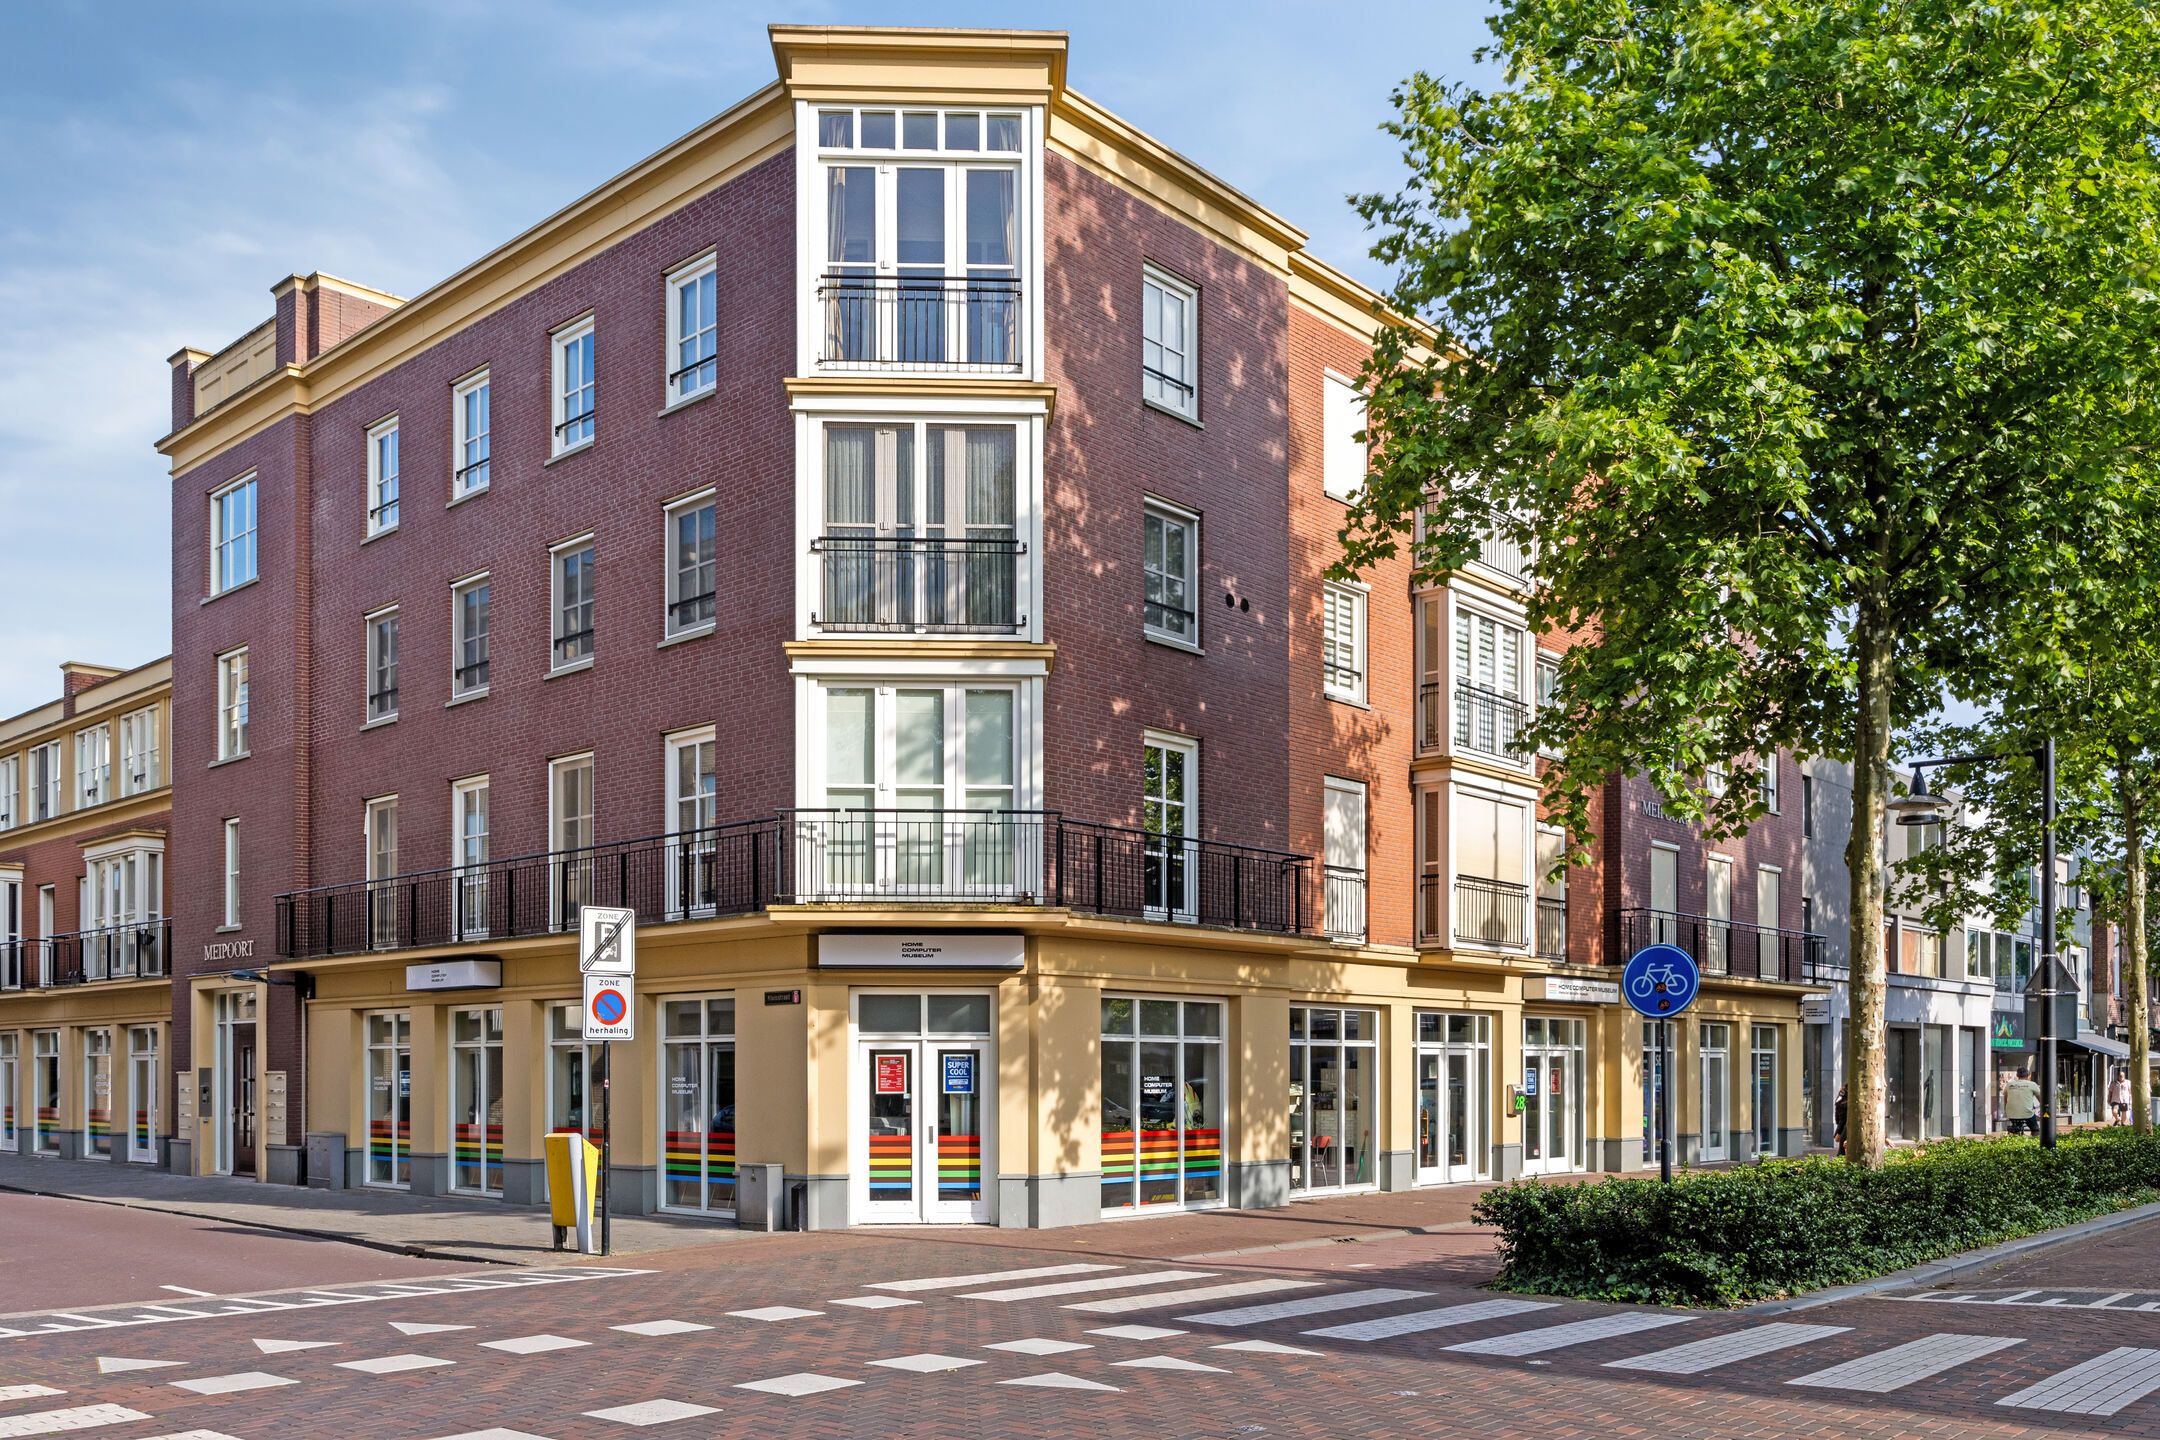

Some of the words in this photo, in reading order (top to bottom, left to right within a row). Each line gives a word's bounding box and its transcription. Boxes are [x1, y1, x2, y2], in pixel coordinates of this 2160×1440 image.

[597, 912, 619, 920] ZONE
[204, 940, 254, 960] MEIPOORT
[589, 1027, 629, 1036] herhaling
[947, 1061, 970, 1069] SUPER
[949, 1068, 968, 1076] COOL
[1515, 1095, 1526, 1110] 28
